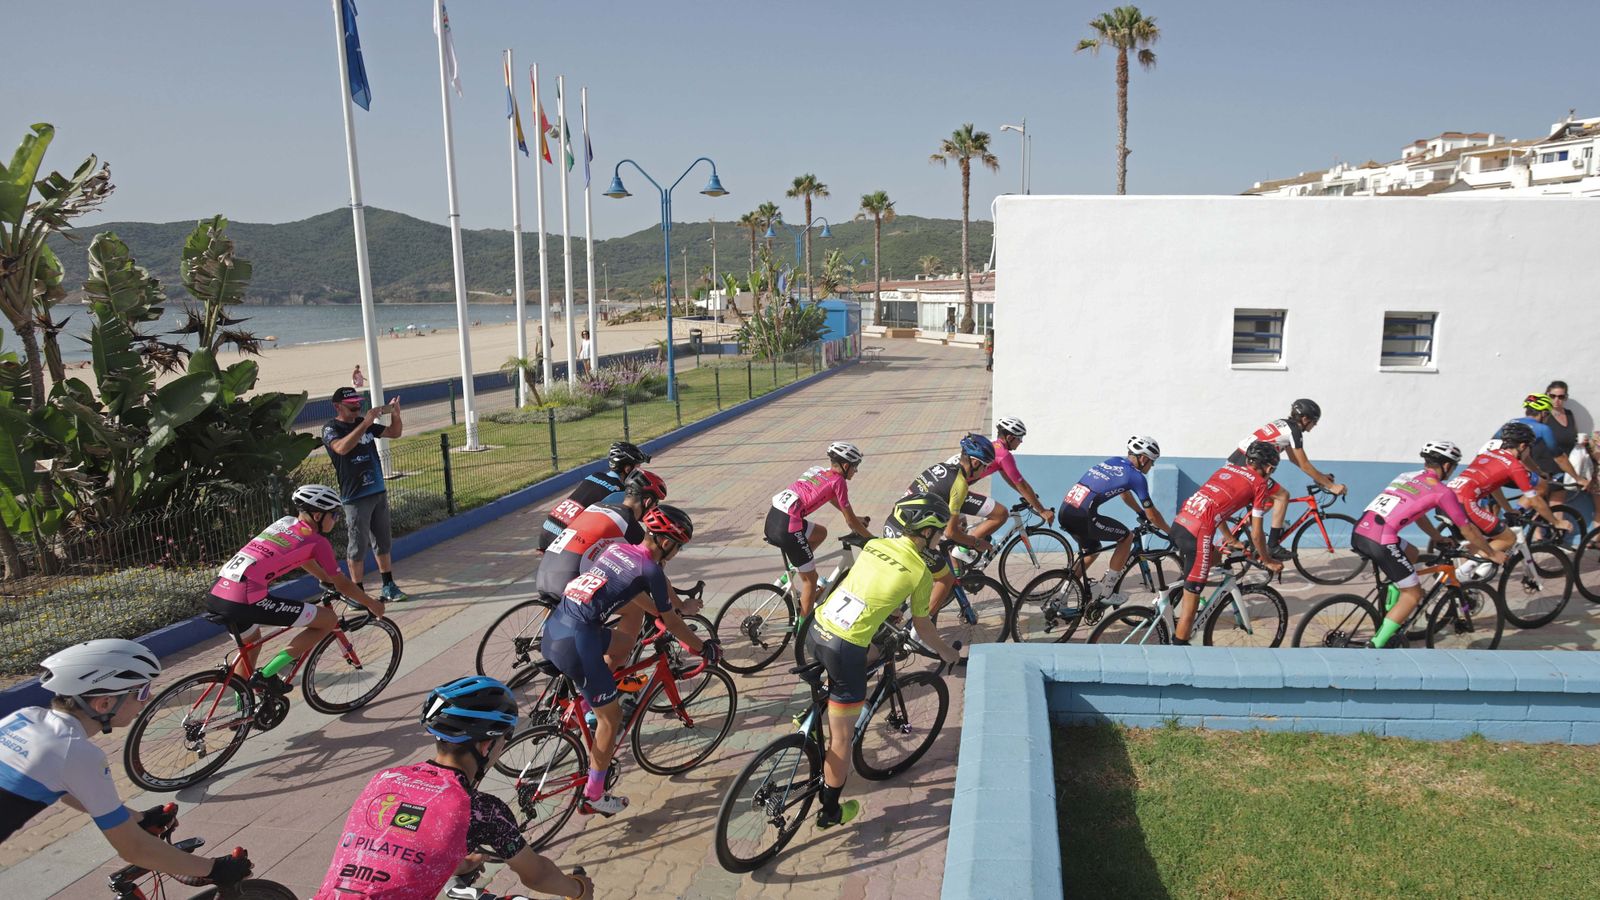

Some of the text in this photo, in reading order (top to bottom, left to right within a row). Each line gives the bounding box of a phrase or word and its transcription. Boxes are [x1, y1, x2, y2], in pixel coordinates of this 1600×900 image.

[779, 491, 792, 505] 13
[1375, 496, 1391, 508] 14
[555, 499, 580, 519] 214
[226, 555, 246, 570] 18
[863, 545, 912, 574] SCOTT
[1199, 534, 1212, 579] TREBUJENA
[275, 601, 302, 614] Jerez
[836, 595, 852, 613] 7
[354, 836, 426, 865] PILATES
